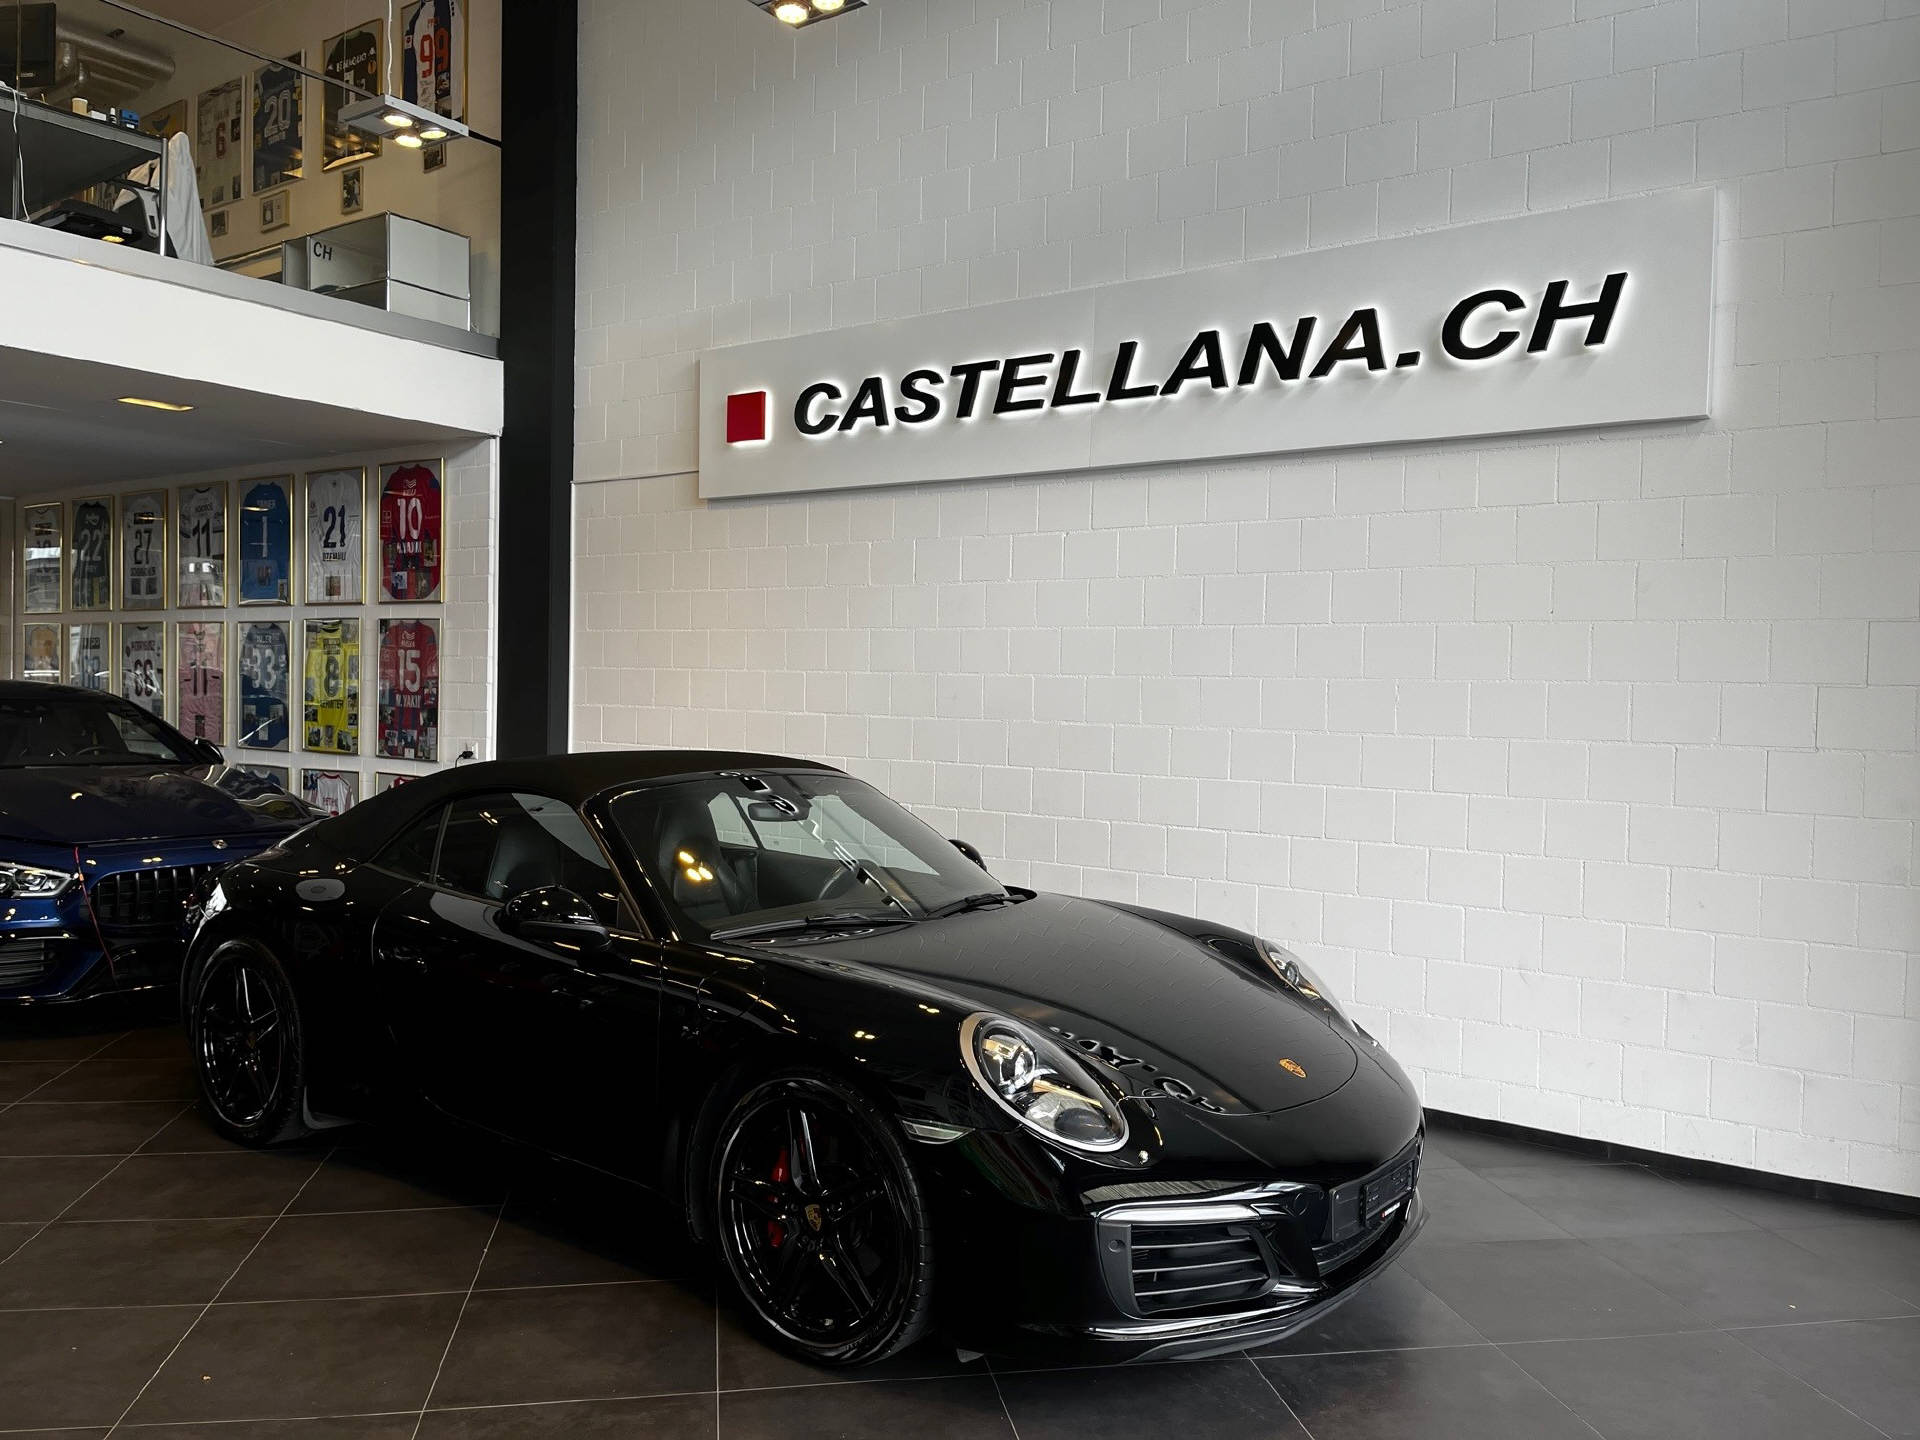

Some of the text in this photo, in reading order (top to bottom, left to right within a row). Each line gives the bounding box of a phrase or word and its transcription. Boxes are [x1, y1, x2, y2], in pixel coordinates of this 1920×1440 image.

[264, 89, 291, 138] 20
[313, 241, 333, 261] CH
[793, 271, 1630, 437] CASTELLANA.CH
[192, 518, 211, 558] 11
[323, 504, 346, 549] 21
[396, 497, 422, 540] 10
[81, 528, 102, 561] 22
[134, 528, 153, 565] 27
[325, 656, 340, 698] 8
[397, 649, 421, 693] 15
